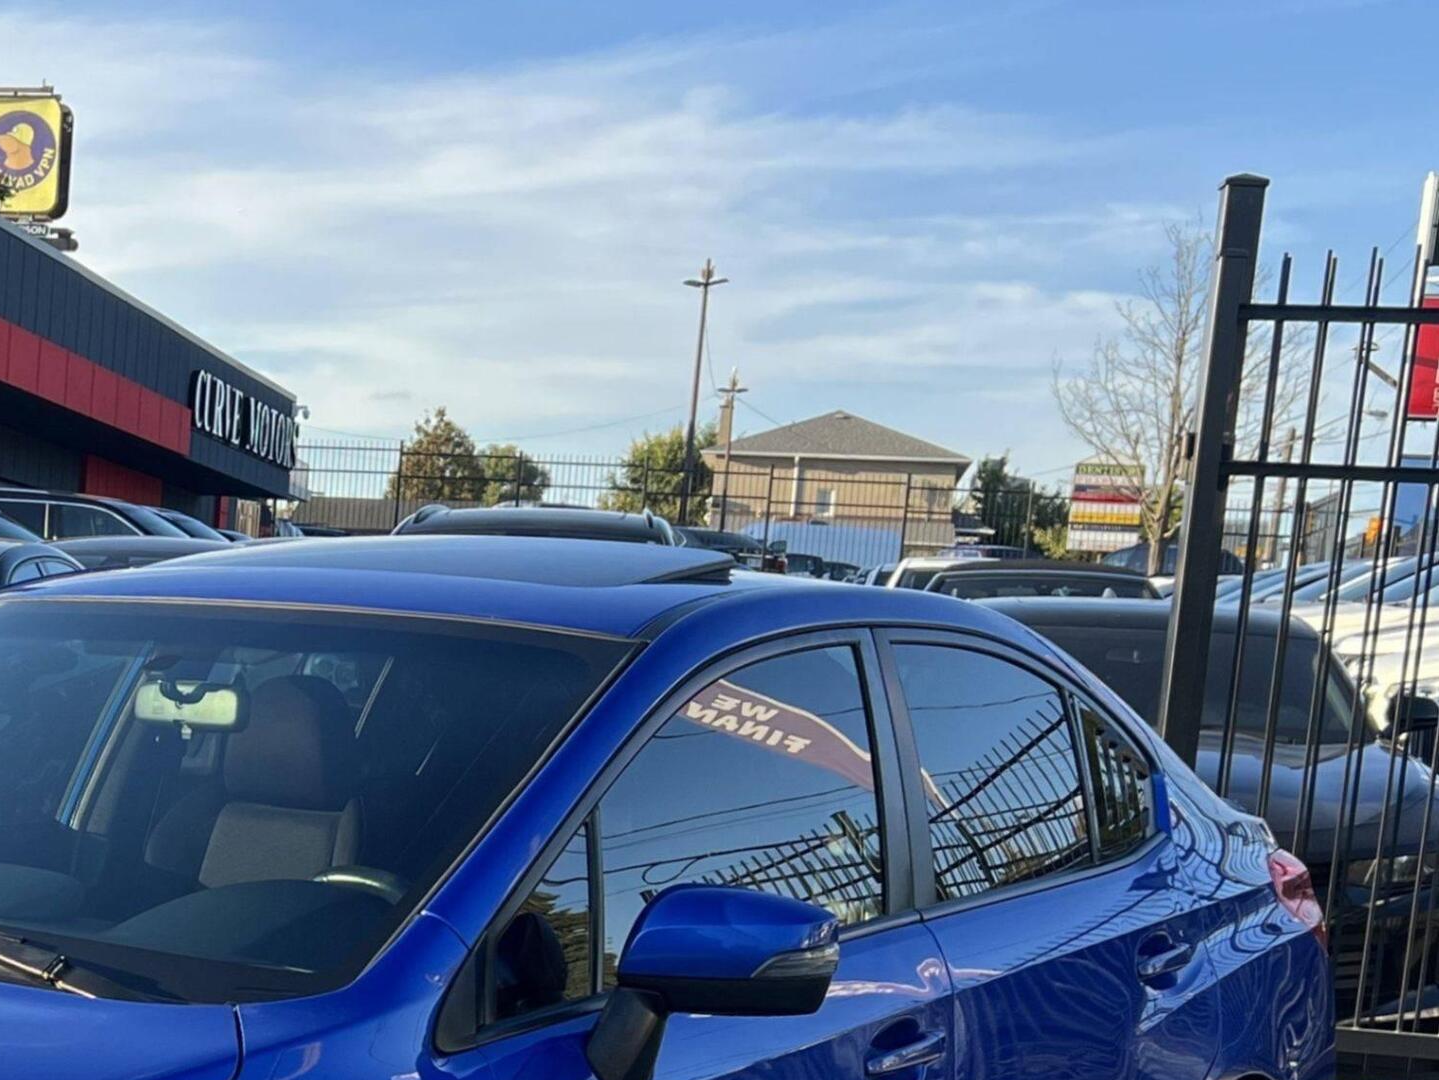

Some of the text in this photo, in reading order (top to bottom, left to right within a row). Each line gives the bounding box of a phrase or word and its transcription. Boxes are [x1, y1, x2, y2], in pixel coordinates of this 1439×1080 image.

[33, 146, 56, 178] VPN
[194, 369, 298, 469] CURVE MOTORS
